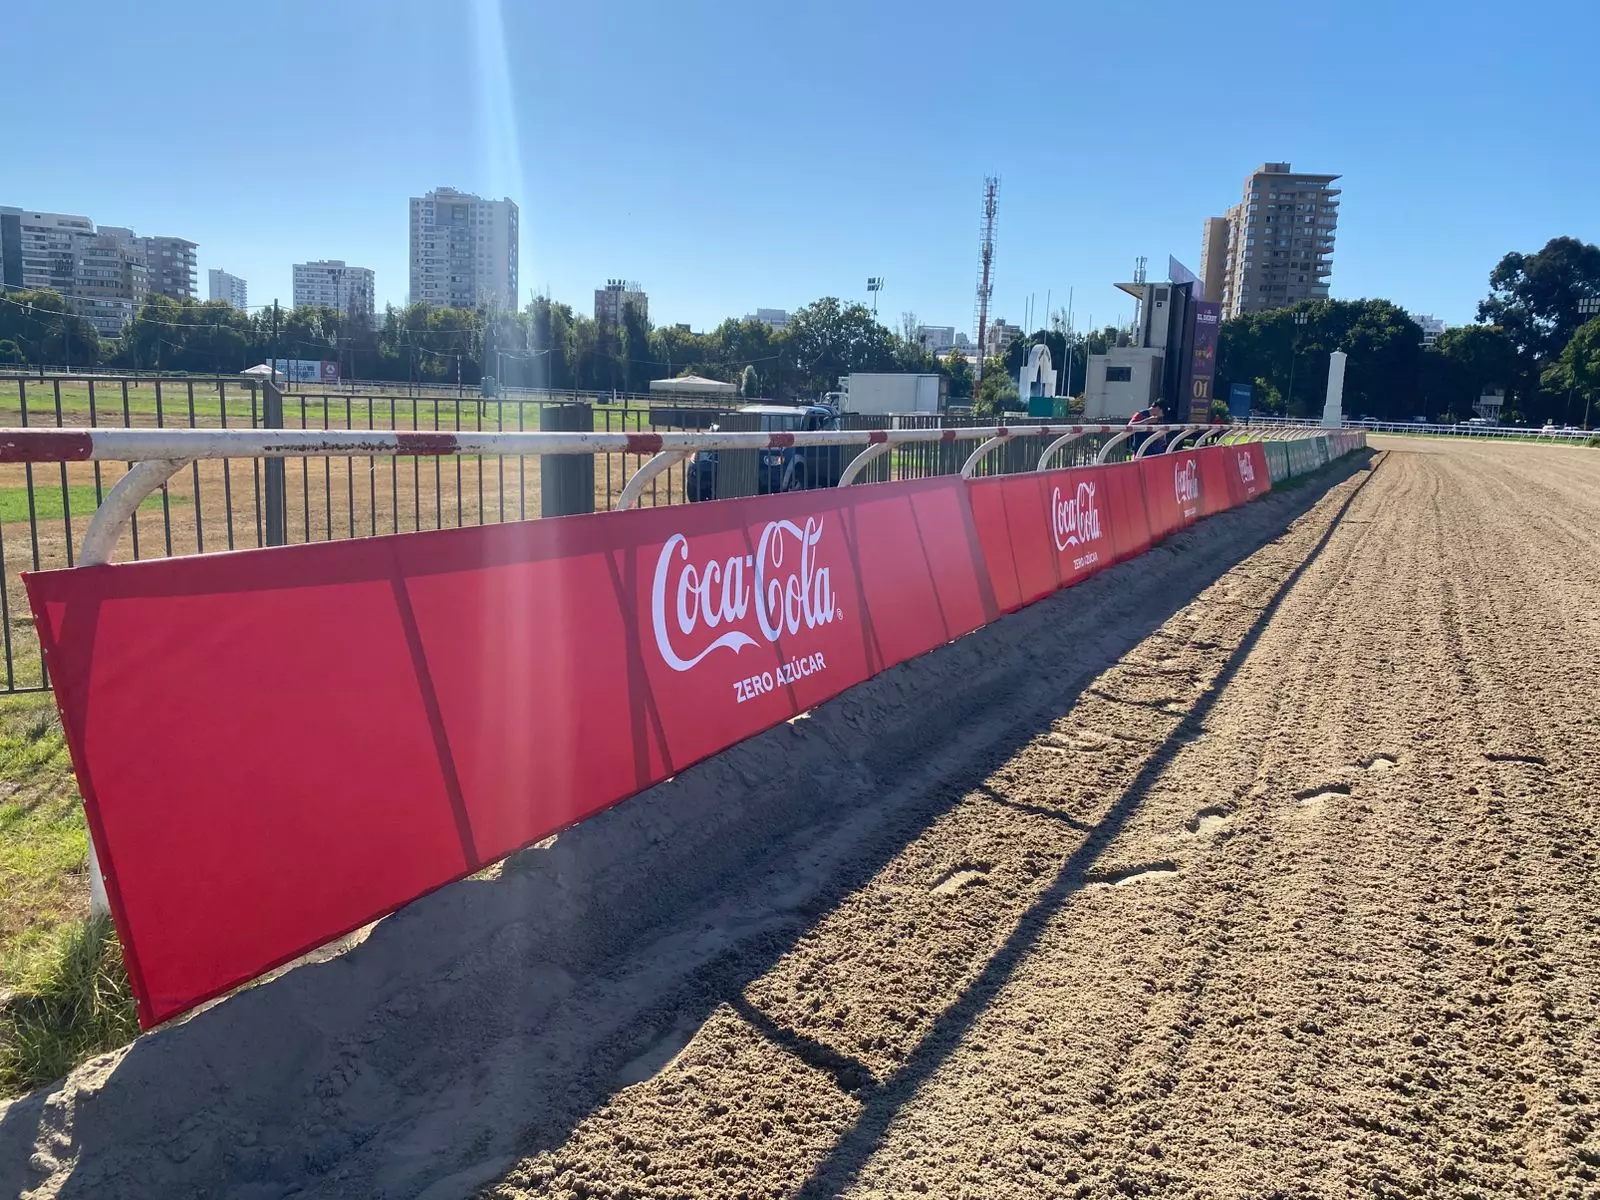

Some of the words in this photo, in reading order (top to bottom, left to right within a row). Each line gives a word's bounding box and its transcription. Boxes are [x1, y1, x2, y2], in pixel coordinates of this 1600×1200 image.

[1193, 380, 1208, 398] 01
[1052, 481, 1101, 552] Coca-Cola
[652, 514, 835, 672] Coca-Cola
[733, 671, 774, 704] ZERO
[775, 651, 827, 688] AZÚCAR
